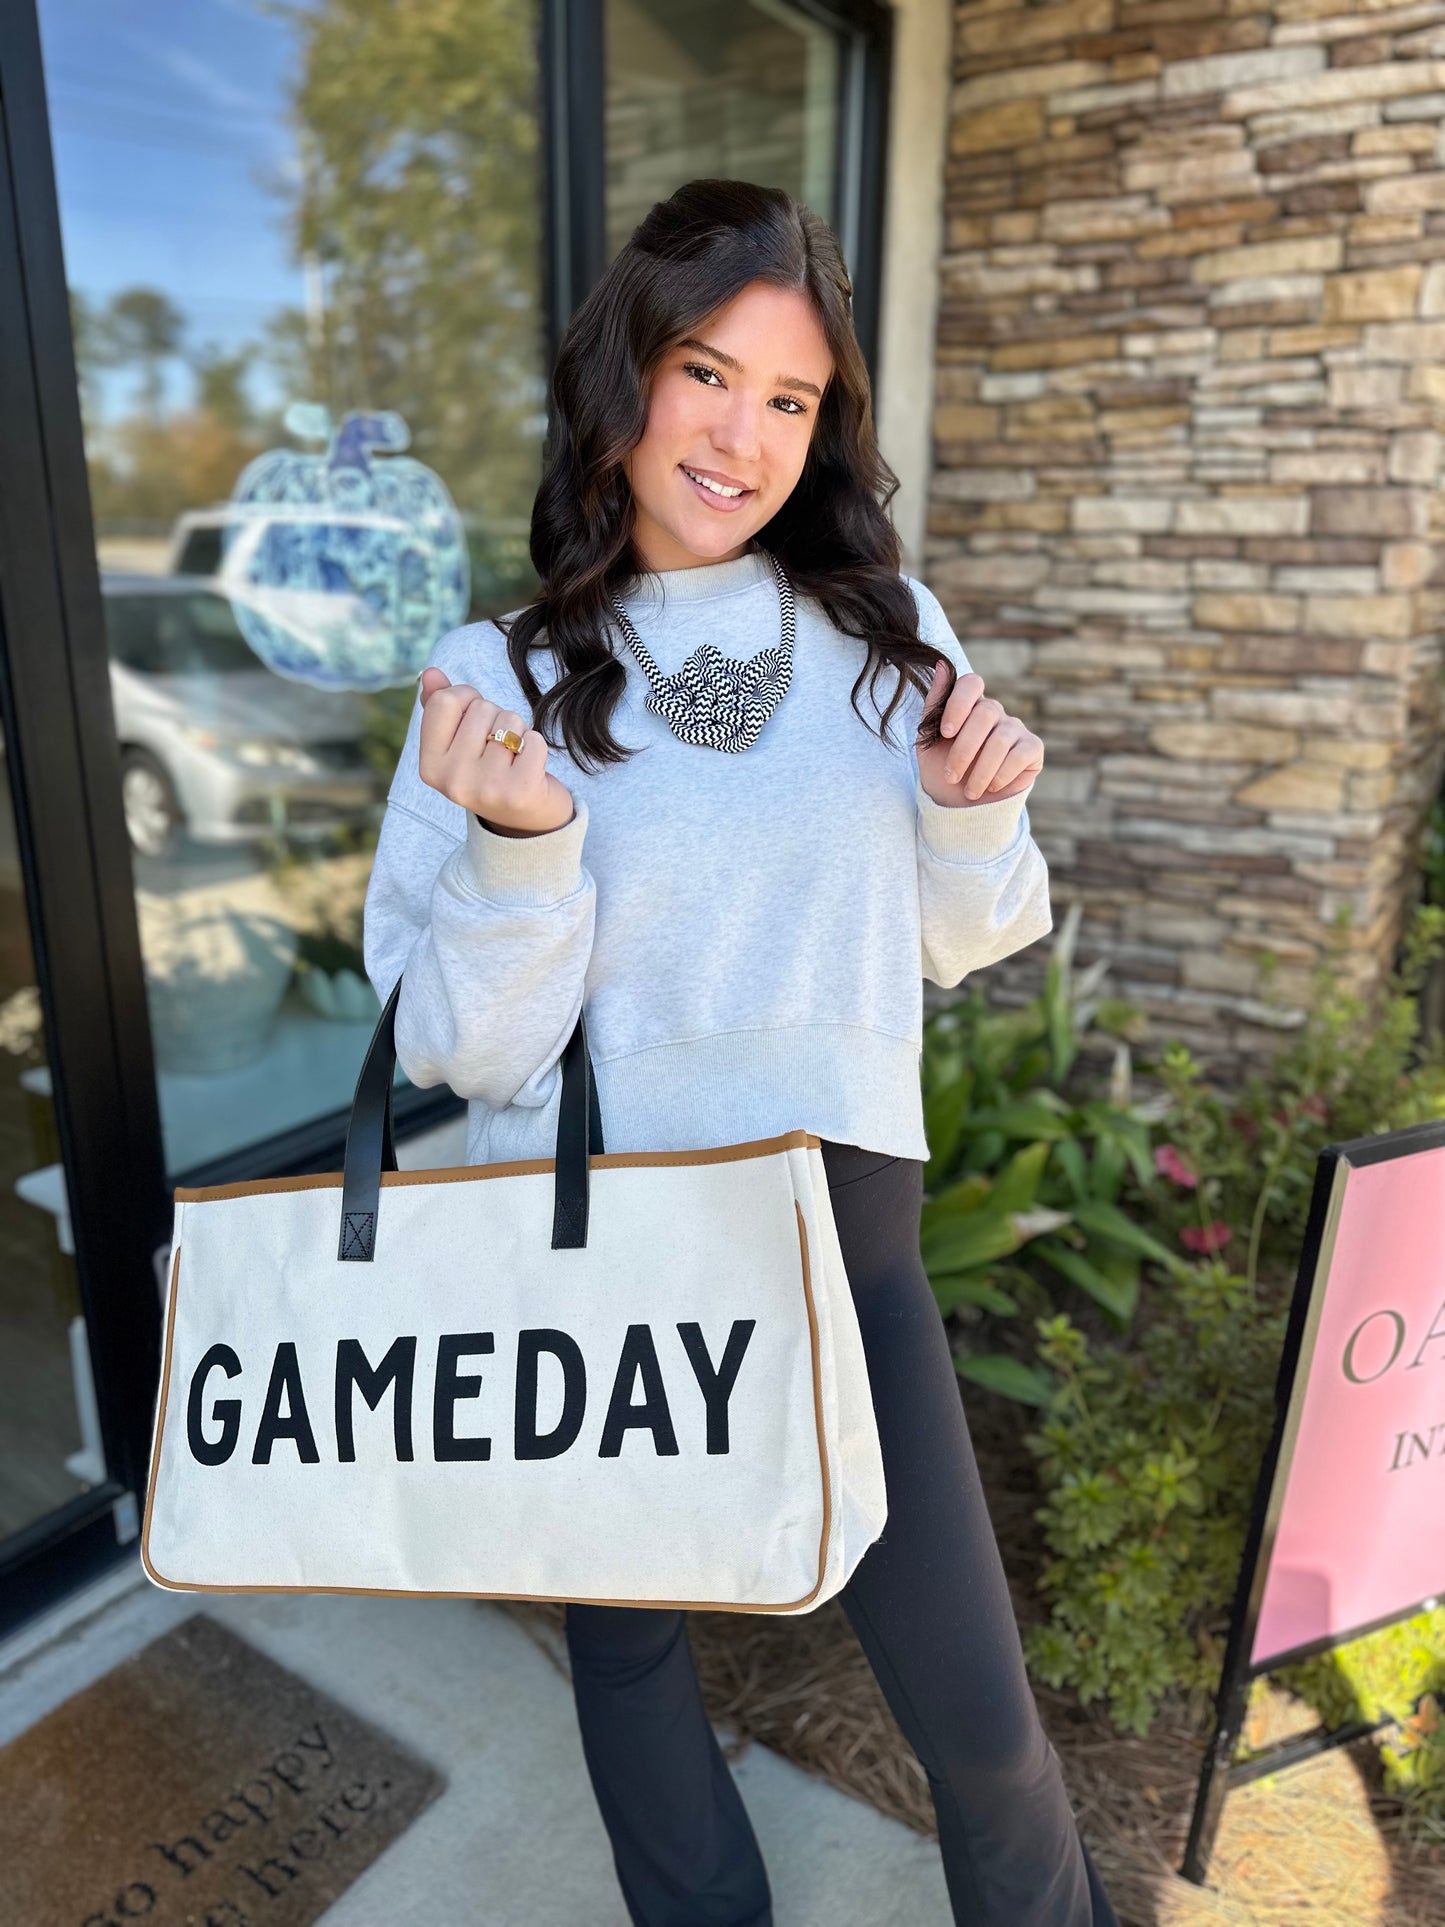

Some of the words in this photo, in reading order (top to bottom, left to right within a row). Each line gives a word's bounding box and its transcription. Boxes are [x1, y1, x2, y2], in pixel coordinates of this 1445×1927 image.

[186, 1319, 757, 1466] GAMEDAY
[1388, 1421, 1445, 1472] IN
[153, 1722, 335, 1878] happy
[237, 1778, 392, 1898] here.
